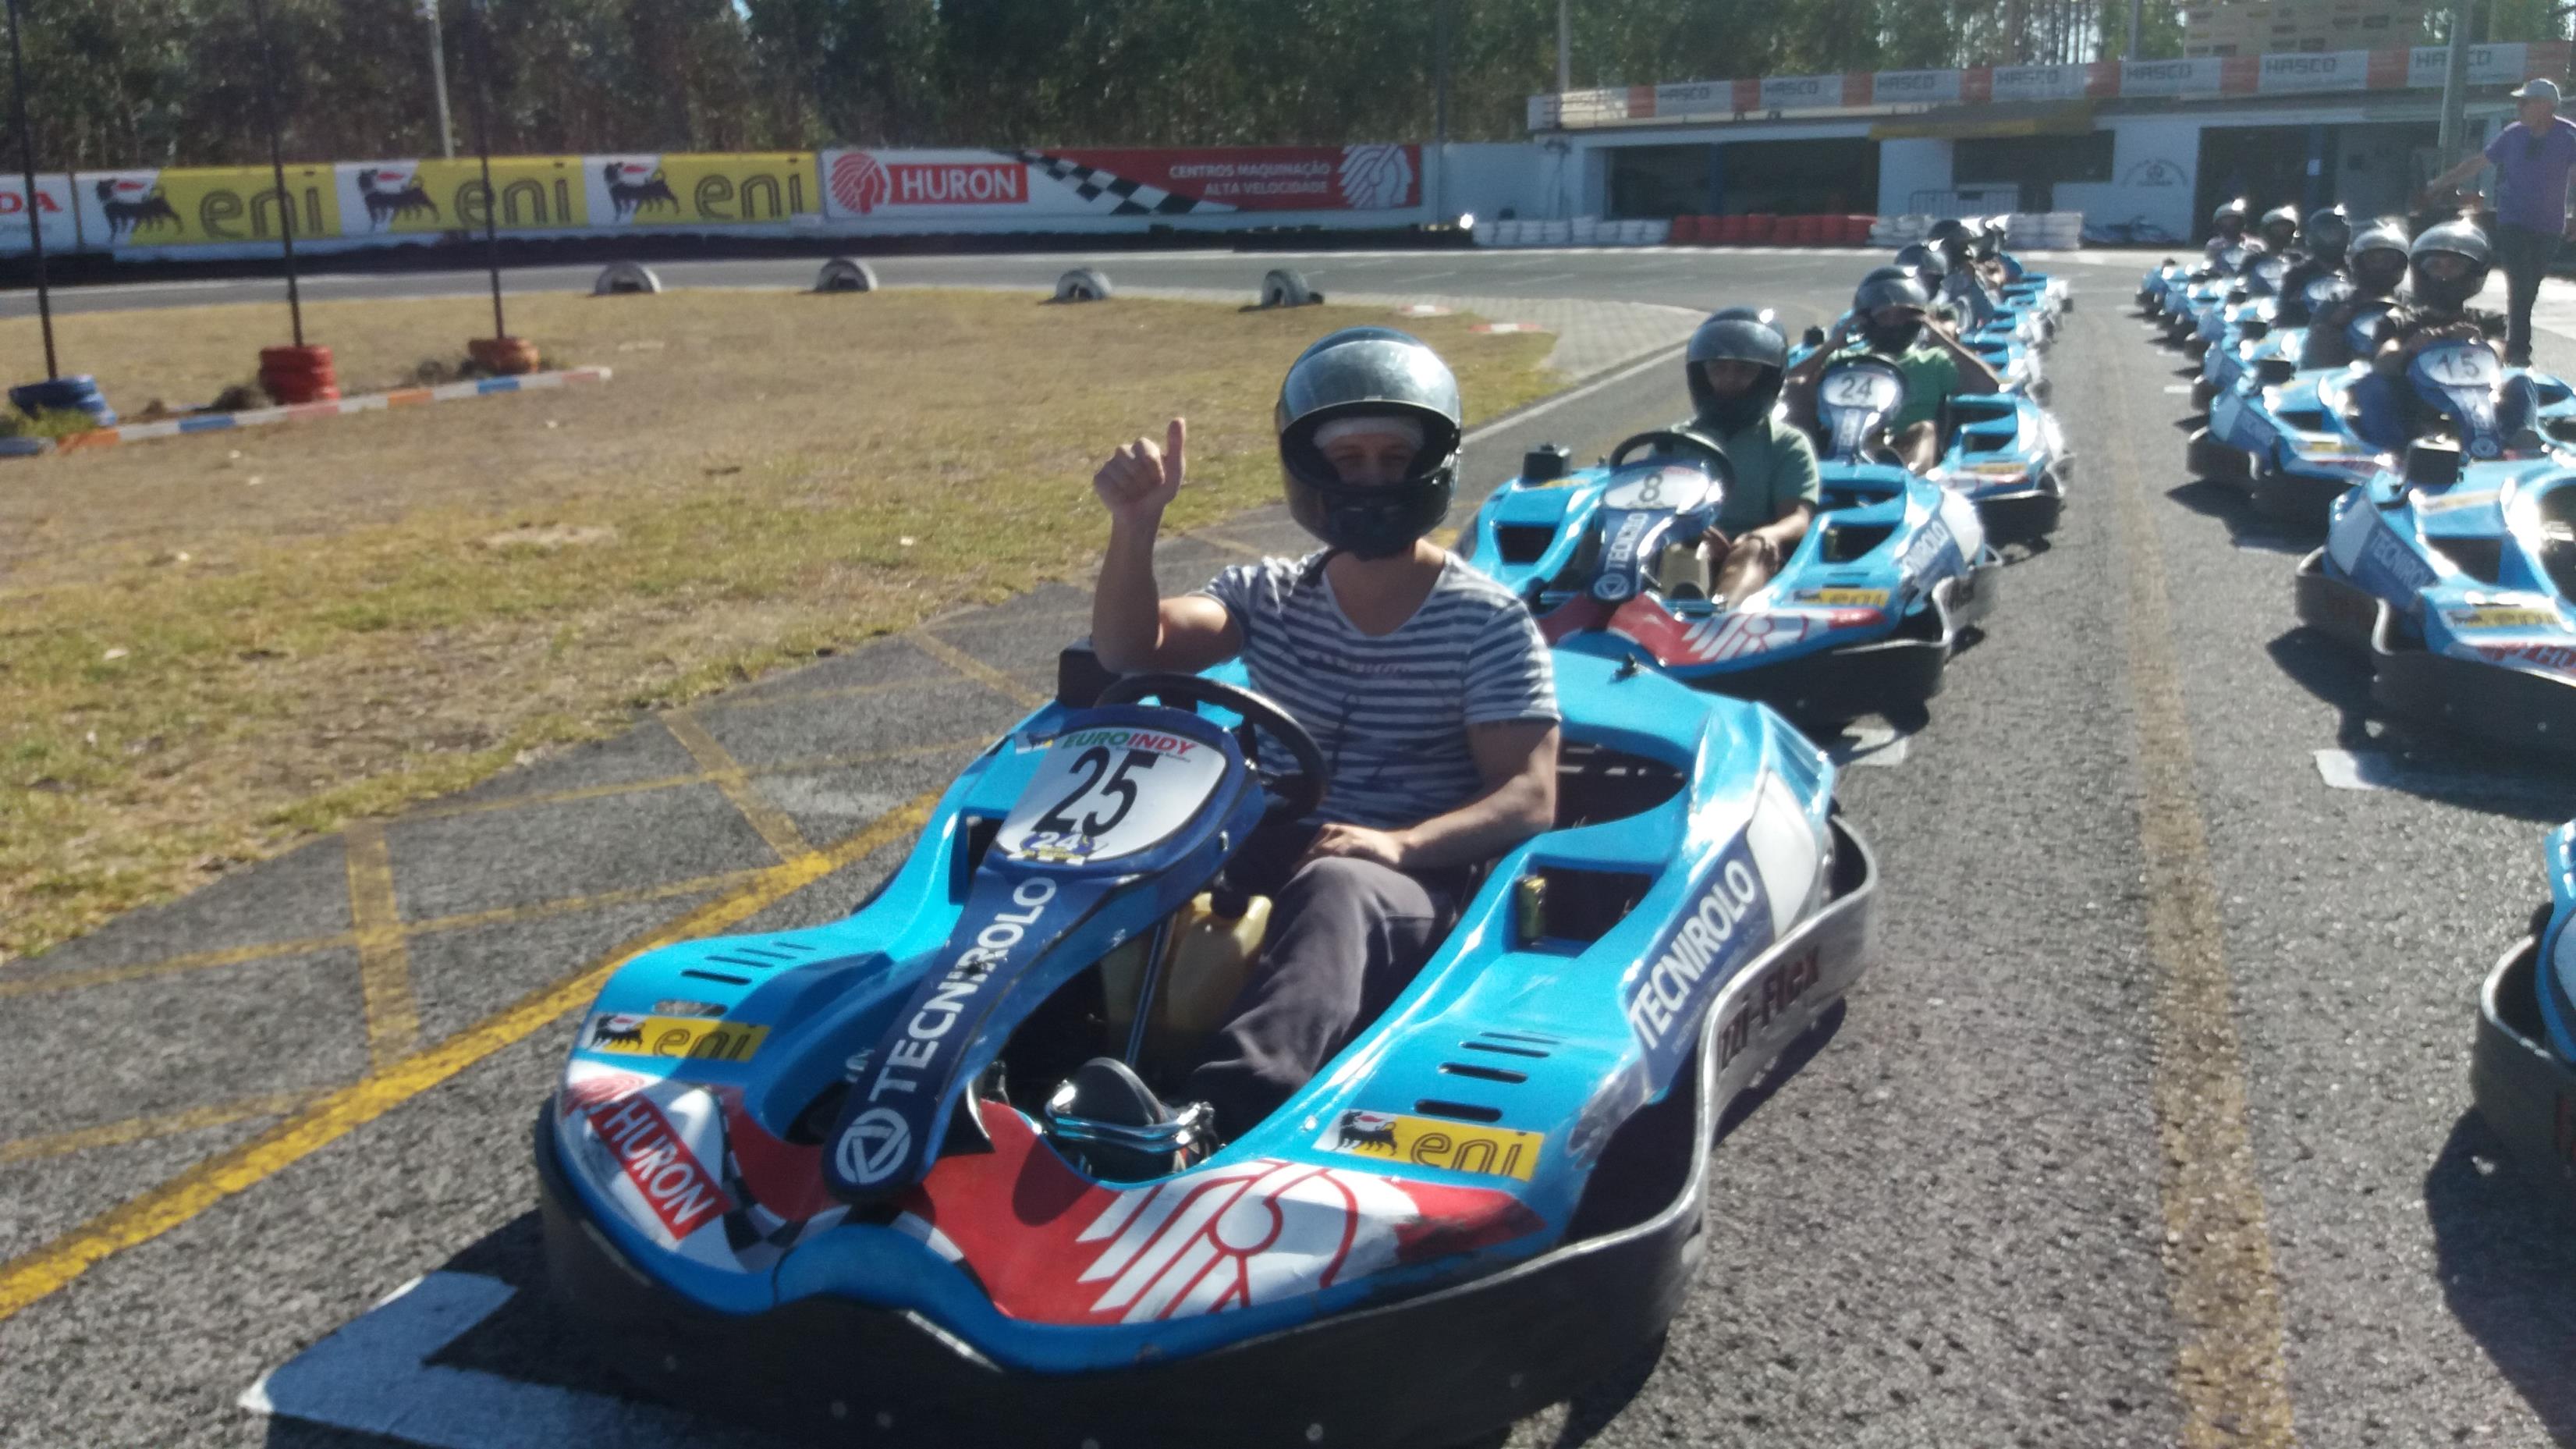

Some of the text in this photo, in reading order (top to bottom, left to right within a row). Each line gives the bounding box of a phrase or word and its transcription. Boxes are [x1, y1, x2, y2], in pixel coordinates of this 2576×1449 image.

[2266, 57, 2336, 74] HASCO
[2415, 50, 2491, 66] HACO
[900, 169, 1017, 200] HURON
[1170, 165, 1235, 179] CENTROS
[455, 162, 570, 226] eni
[694, 157, 803, 220] eni
[1204, 183, 1240, 195] ALTA
[200, 171, 324, 237] eni
[2438, 353, 2480, 378] 15
[1840, 375, 1873, 400] 24
[1638, 473, 1663, 502] 8
[1061, 730, 1198, 755] EUROINDY
[1031, 745, 1159, 837] 25
[1029, 831, 1083, 851] 24
[1629, 858, 1756, 1049] TECNIROLO
[652, 1022, 755, 1061] eni
[603, 1099, 716, 1226] HURON
[1410, 1131, 1527, 1176] eni
